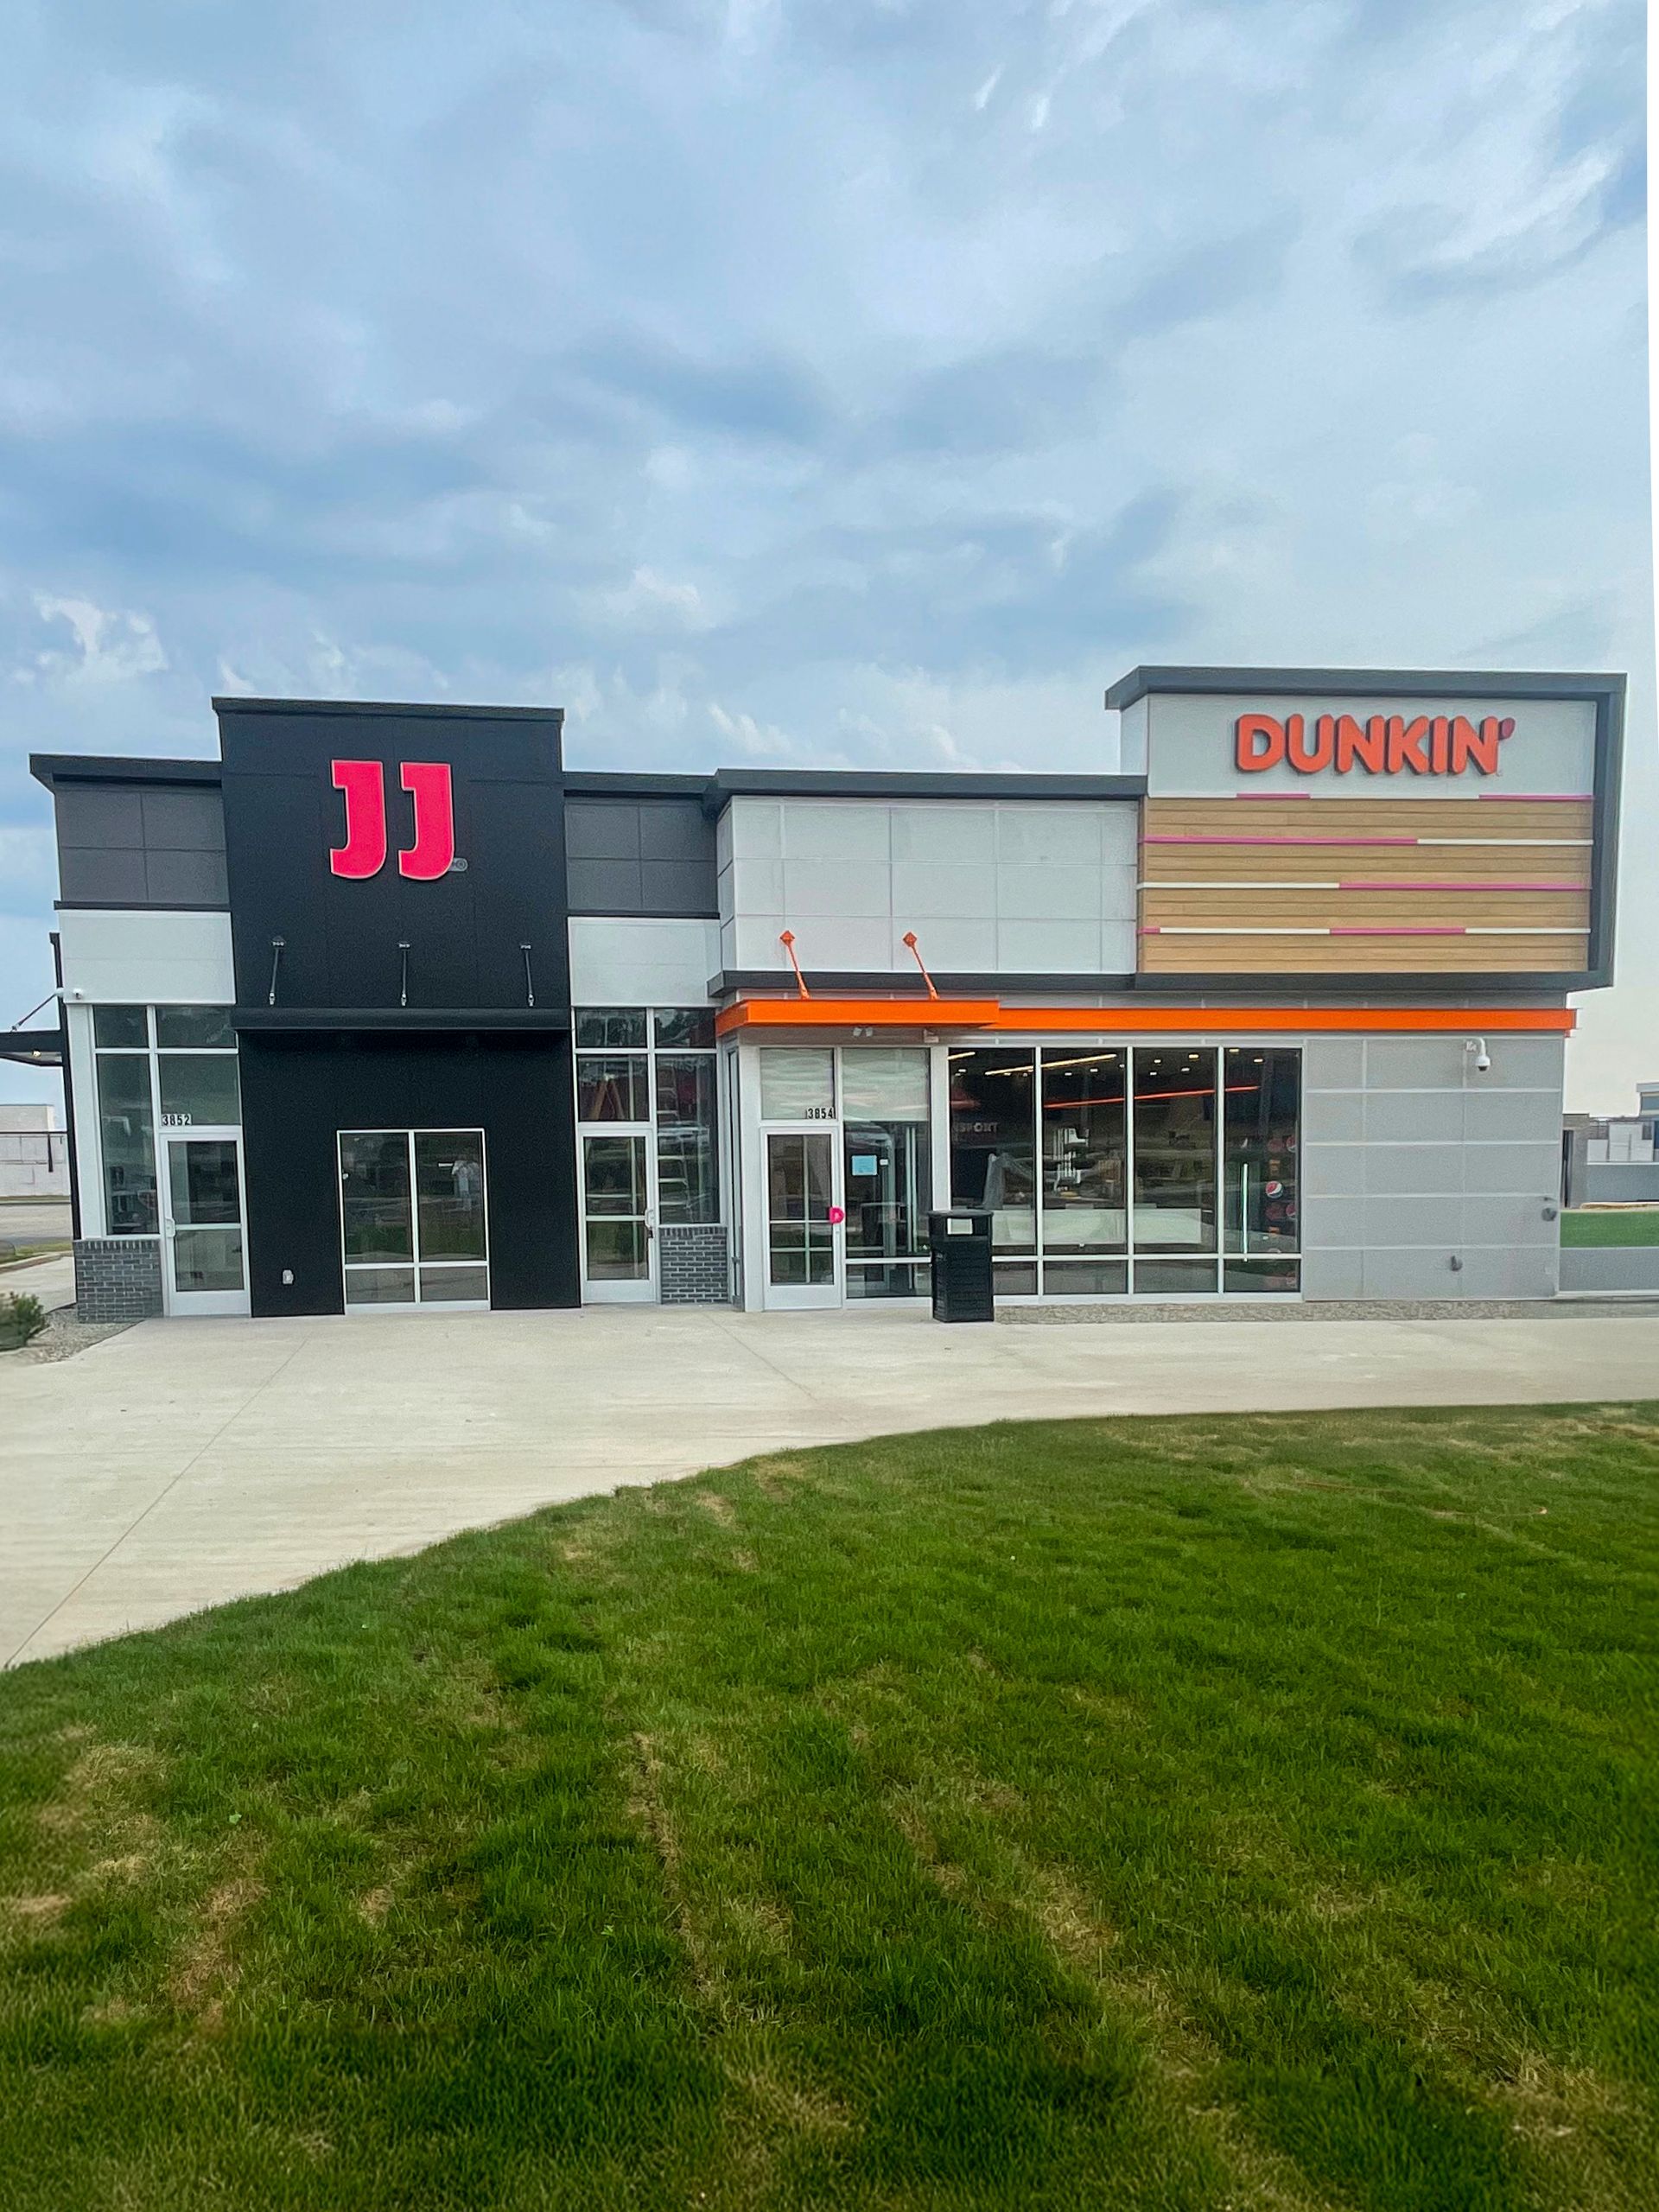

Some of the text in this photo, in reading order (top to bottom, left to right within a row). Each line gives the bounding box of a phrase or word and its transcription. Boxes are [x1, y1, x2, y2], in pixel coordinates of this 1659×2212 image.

[1236, 713, 1516, 775] DUNKIN'
[329, 759, 454, 880] JJ
[162, 1114, 191, 1126] 3852
[807, 1107, 834, 1119] 3854
